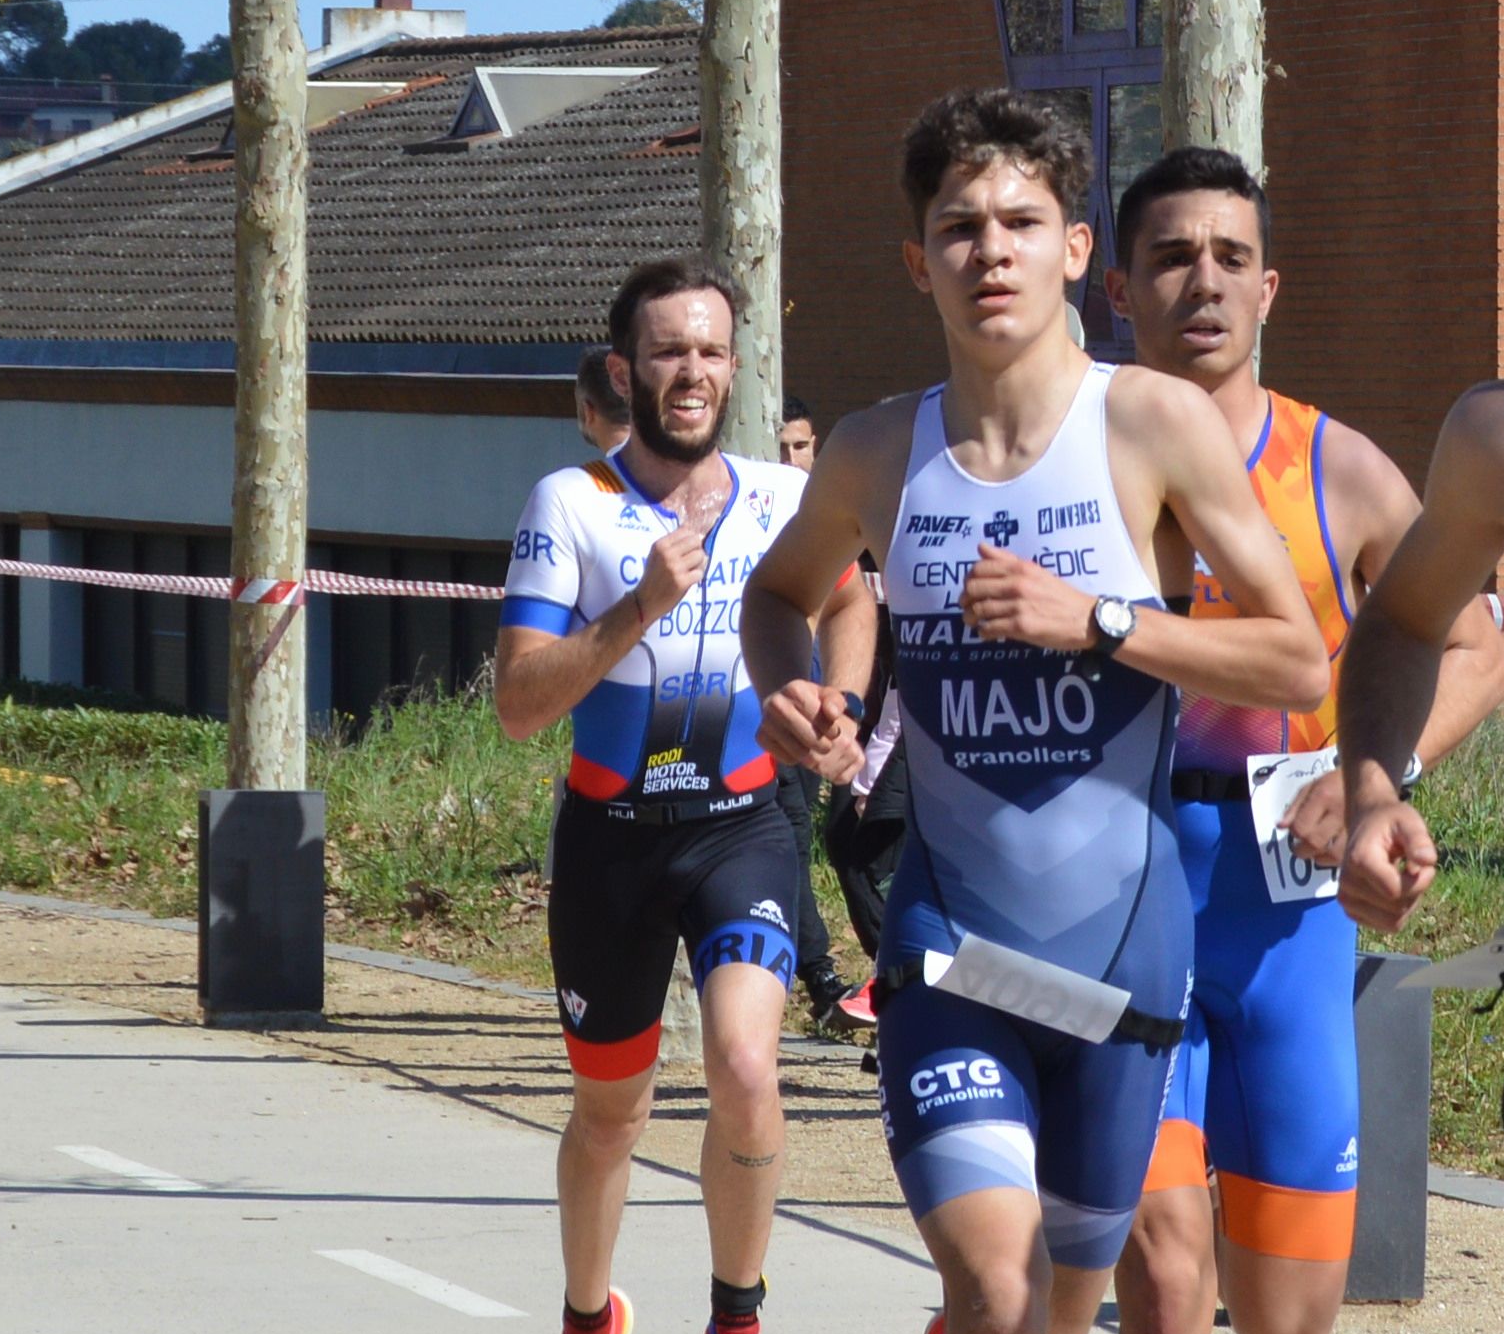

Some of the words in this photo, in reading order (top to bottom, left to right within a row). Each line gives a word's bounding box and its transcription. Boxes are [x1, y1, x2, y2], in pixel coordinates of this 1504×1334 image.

[906, 515, 971, 535] RAVET
[918, 535, 947, 548] BIKE
[913, 560, 977, 587] CENT
[659, 671, 728, 703] SBR
[940, 660, 1096, 738] MAJÓ
[647, 747, 683, 768] RODI
[954, 745, 1093, 768] granollers
[644, 762, 698, 781] MOTOR
[643, 776, 710, 795] SERVICES
[709, 793, 753, 813] HUUB
[910, 1058, 1002, 1099] CTG
[917, 1087, 1004, 1116] granollers
